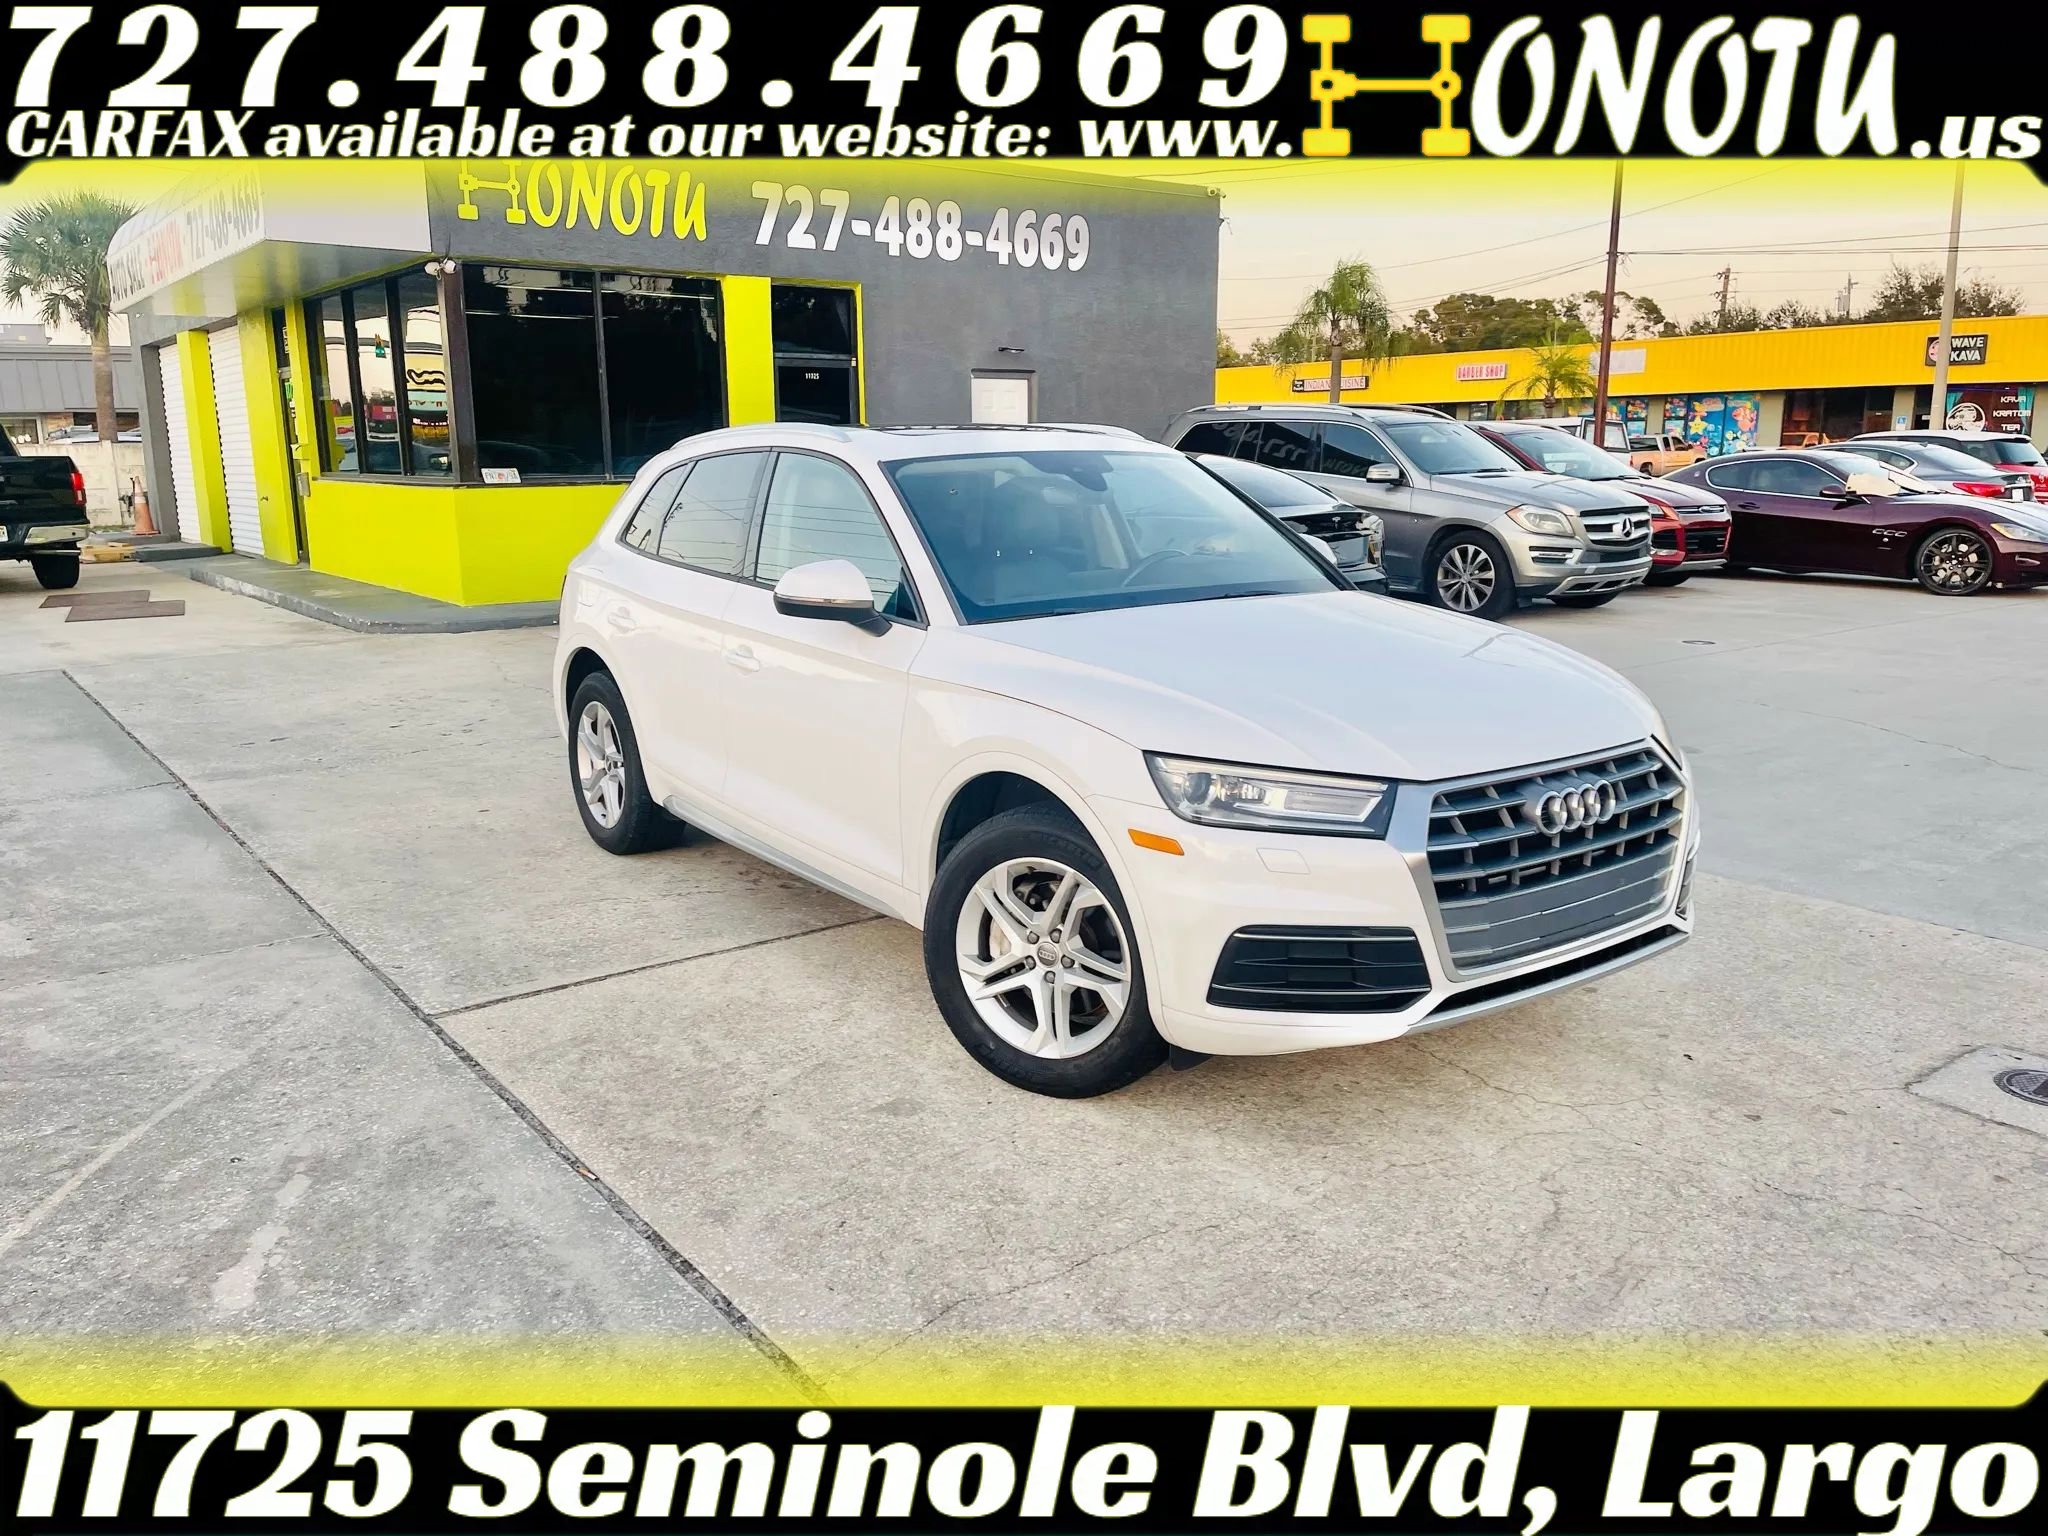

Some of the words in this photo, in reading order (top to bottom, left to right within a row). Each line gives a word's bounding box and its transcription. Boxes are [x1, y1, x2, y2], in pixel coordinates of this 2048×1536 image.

[751, 180, 1090, 271] 727-488-4669
[1951, 336, 1984, 348] WAVE
[1950, 349, 1981, 361] KAVA
[1485, 364, 1504, 377] SHOP
[2000, 395, 2027, 403] KAVA
[2001, 423, 2021, 431] TEA
